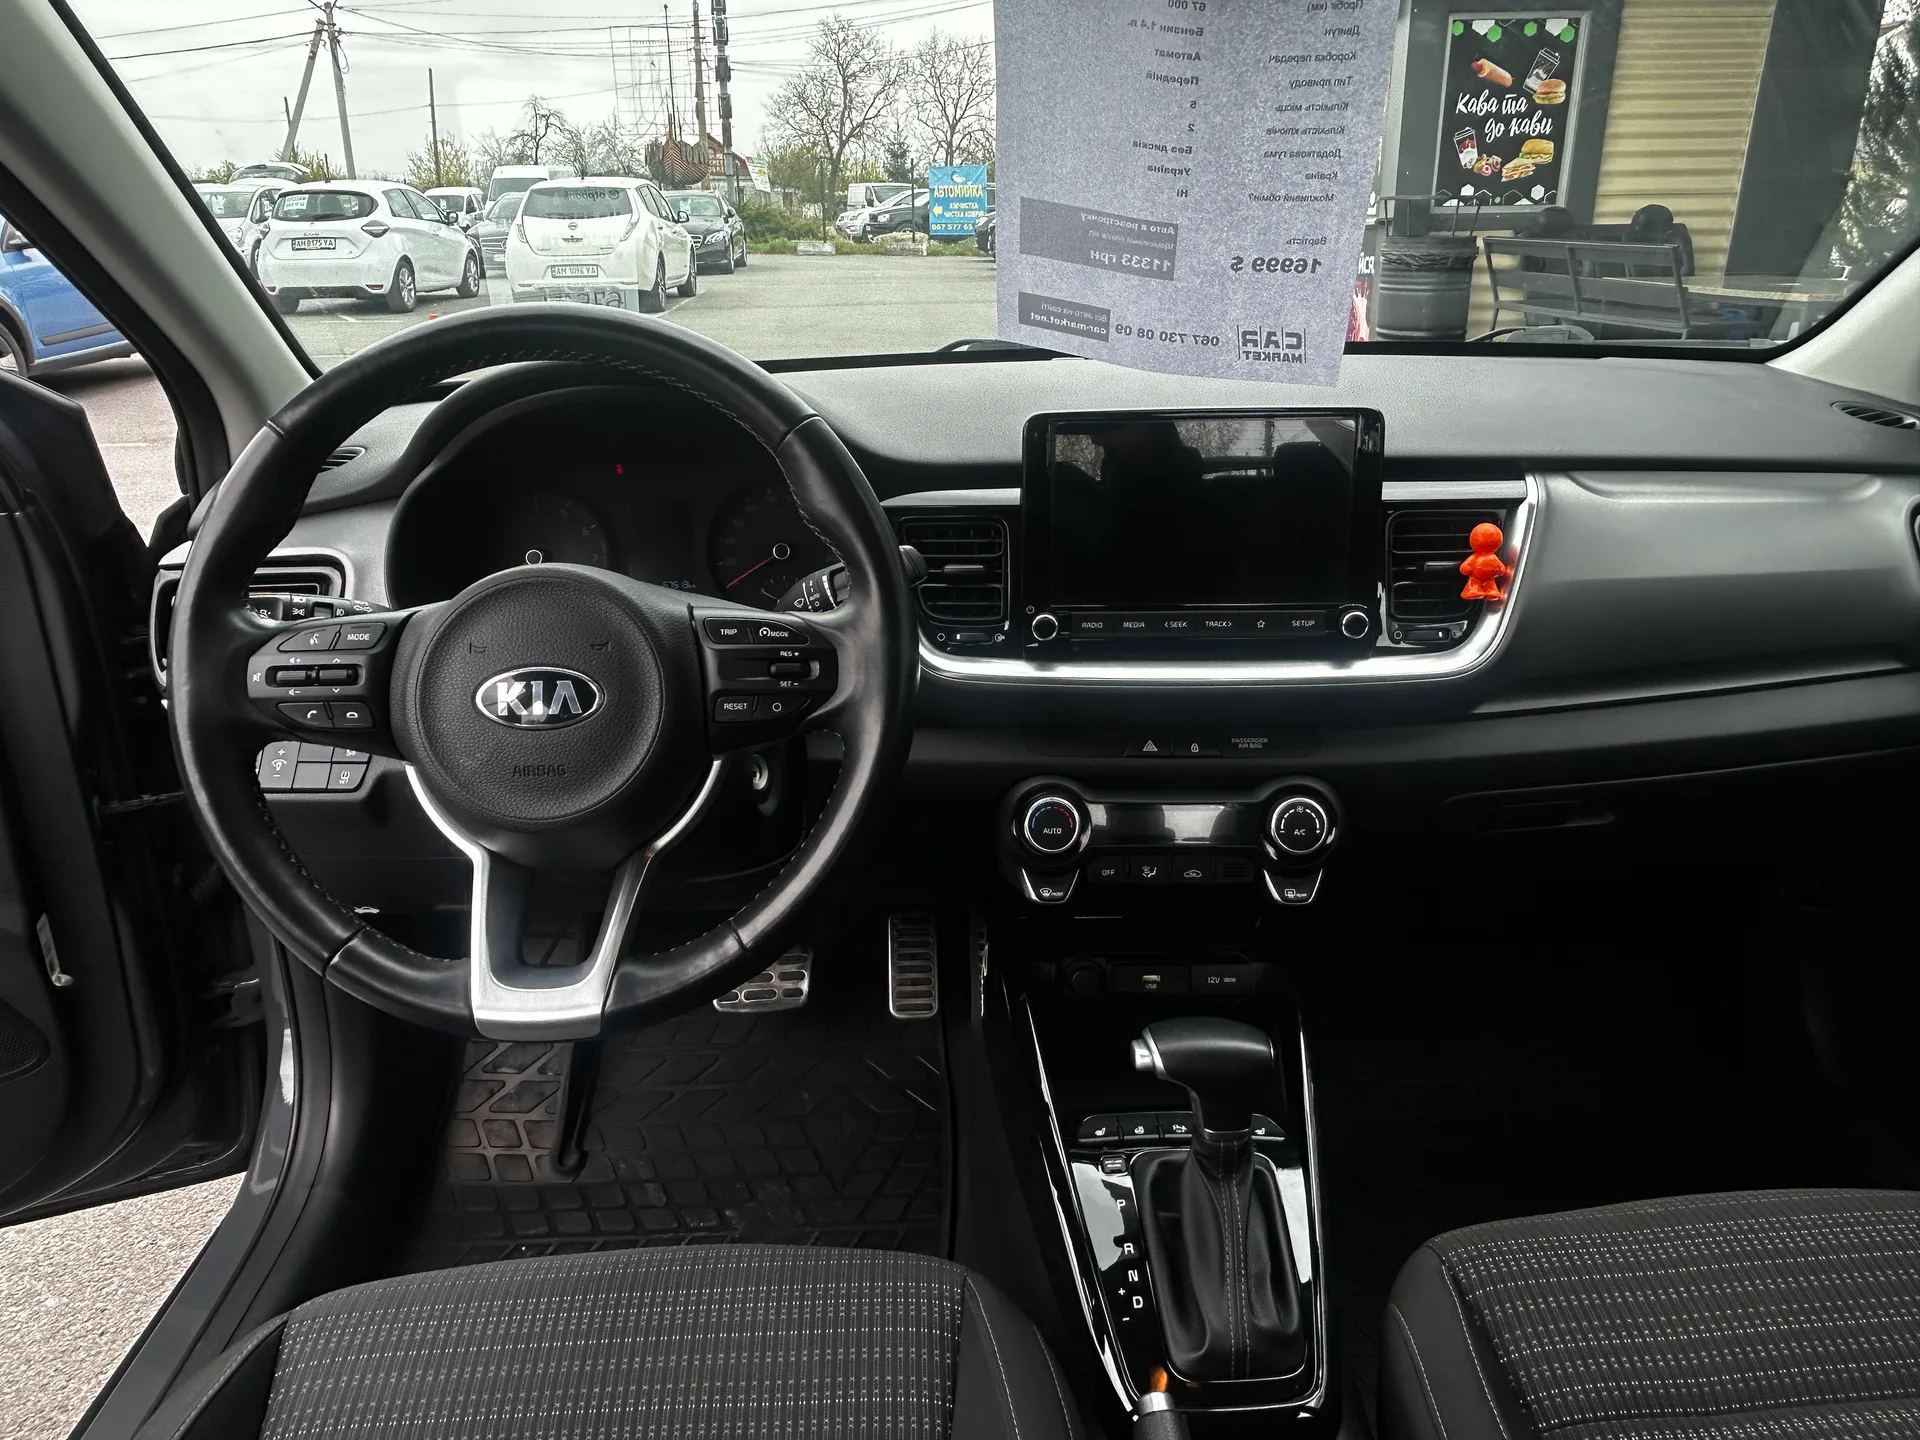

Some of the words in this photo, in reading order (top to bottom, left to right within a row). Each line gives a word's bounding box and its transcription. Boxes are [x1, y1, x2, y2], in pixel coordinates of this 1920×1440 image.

[1455, 89, 1500, 116] Кава
[1484, 118, 1506, 143] до
[1508, 110, 1554, 137] кави
[933, 181, 984, 198] АВТОМИЙКА
[346, 633, 371, 641] MODE
[720, 628, 738, 636] TRIP
[496, 680, 582, 716] KIA
[723, 702, 748, 710] RESET
[511, 764, 567, 778] AIRBAG
[1042, 827, 1062, 835] AUTO
[1293, 828, 1306, 836] A/C
[1101, 868, 1116, 876] OFF
[1207, 976, 1221, 984] 12V
[1116, 1199, 1126, 1211] P
[1123, 1242, 1135, 1255] R
[1128, 1269, 1139, 1282] N
[1132, 1296, 1144, 1309] D
